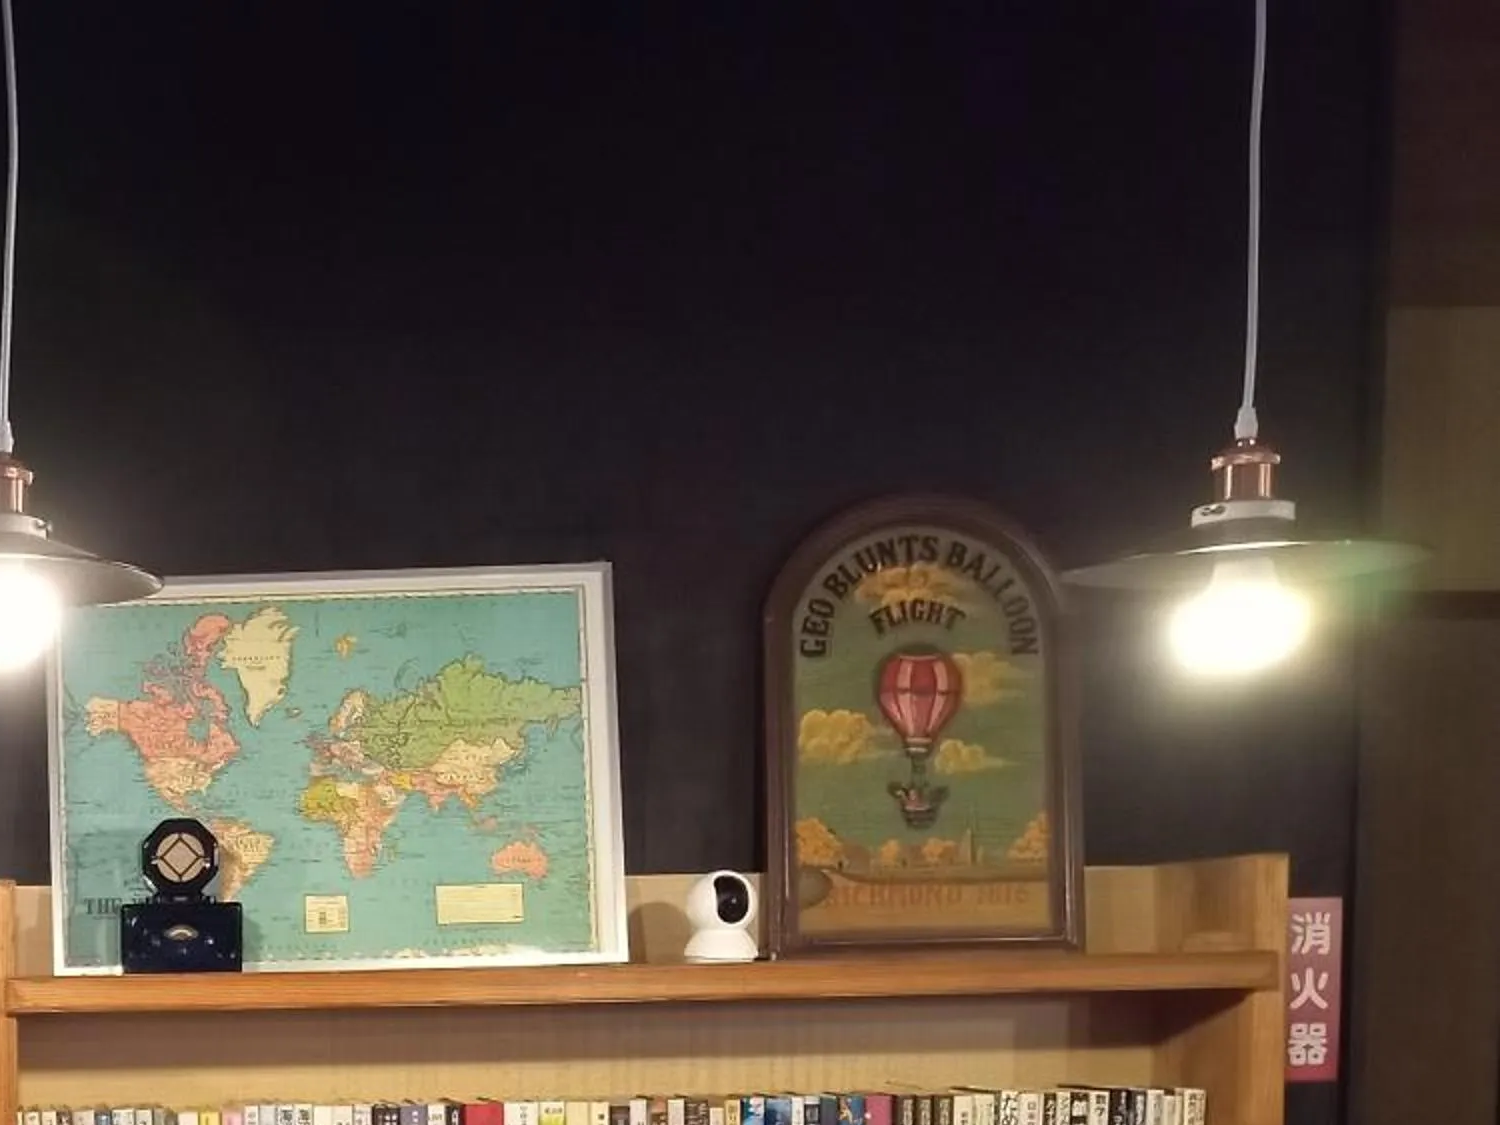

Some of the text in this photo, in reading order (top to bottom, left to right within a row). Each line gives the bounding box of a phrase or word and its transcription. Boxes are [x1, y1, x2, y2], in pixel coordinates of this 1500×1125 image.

[799, 534, 1040, 659] GEO BLUNTS BALLOON
[868, 598, 966, 636] FLIGHT
[1288, 911, 1331, 1067] 消火器
